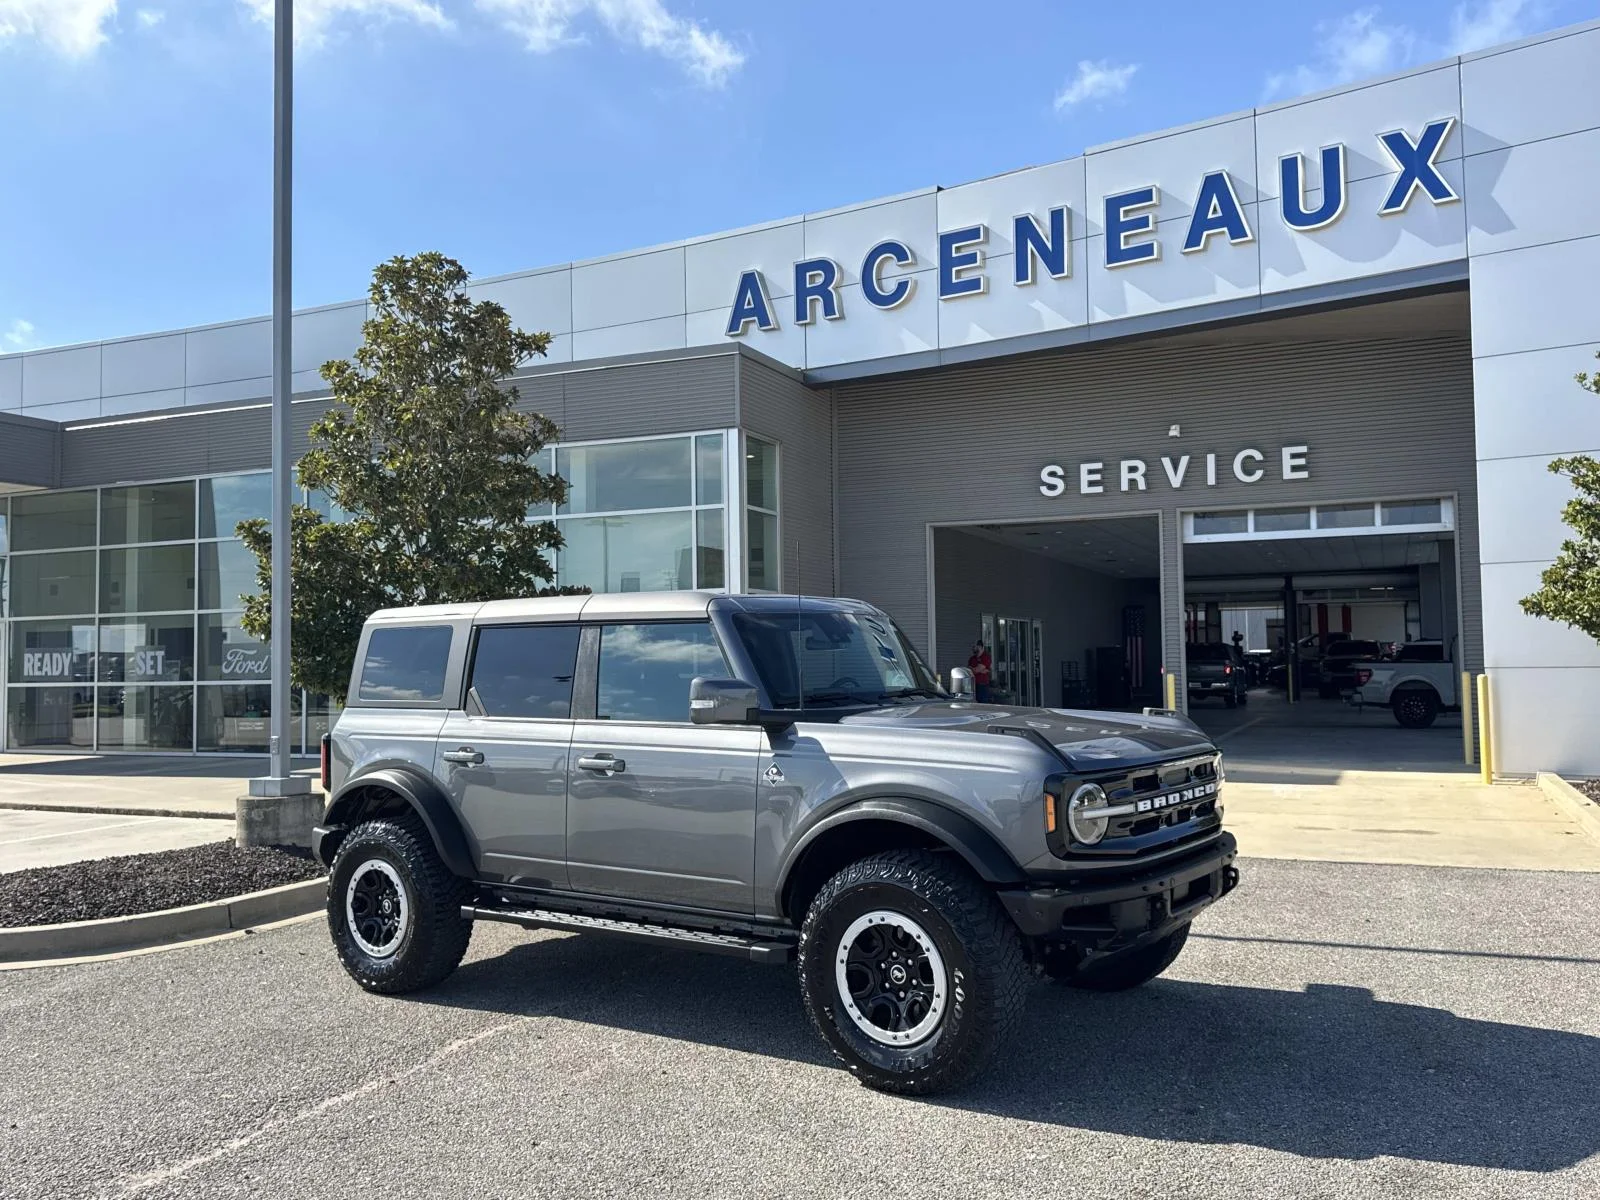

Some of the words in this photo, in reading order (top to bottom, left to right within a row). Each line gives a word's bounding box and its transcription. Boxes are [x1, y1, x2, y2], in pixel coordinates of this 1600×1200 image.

[725, 116, 1460, 337] ARCENEAUX
[1039, 445, 1309, 497] SERVICE
[24, 652, 72, 677] READY
[135, 651, 165, 675] SET
[222, 648, 269, 674] Ford
[1137, 783, 1216, 812] BRONCO
